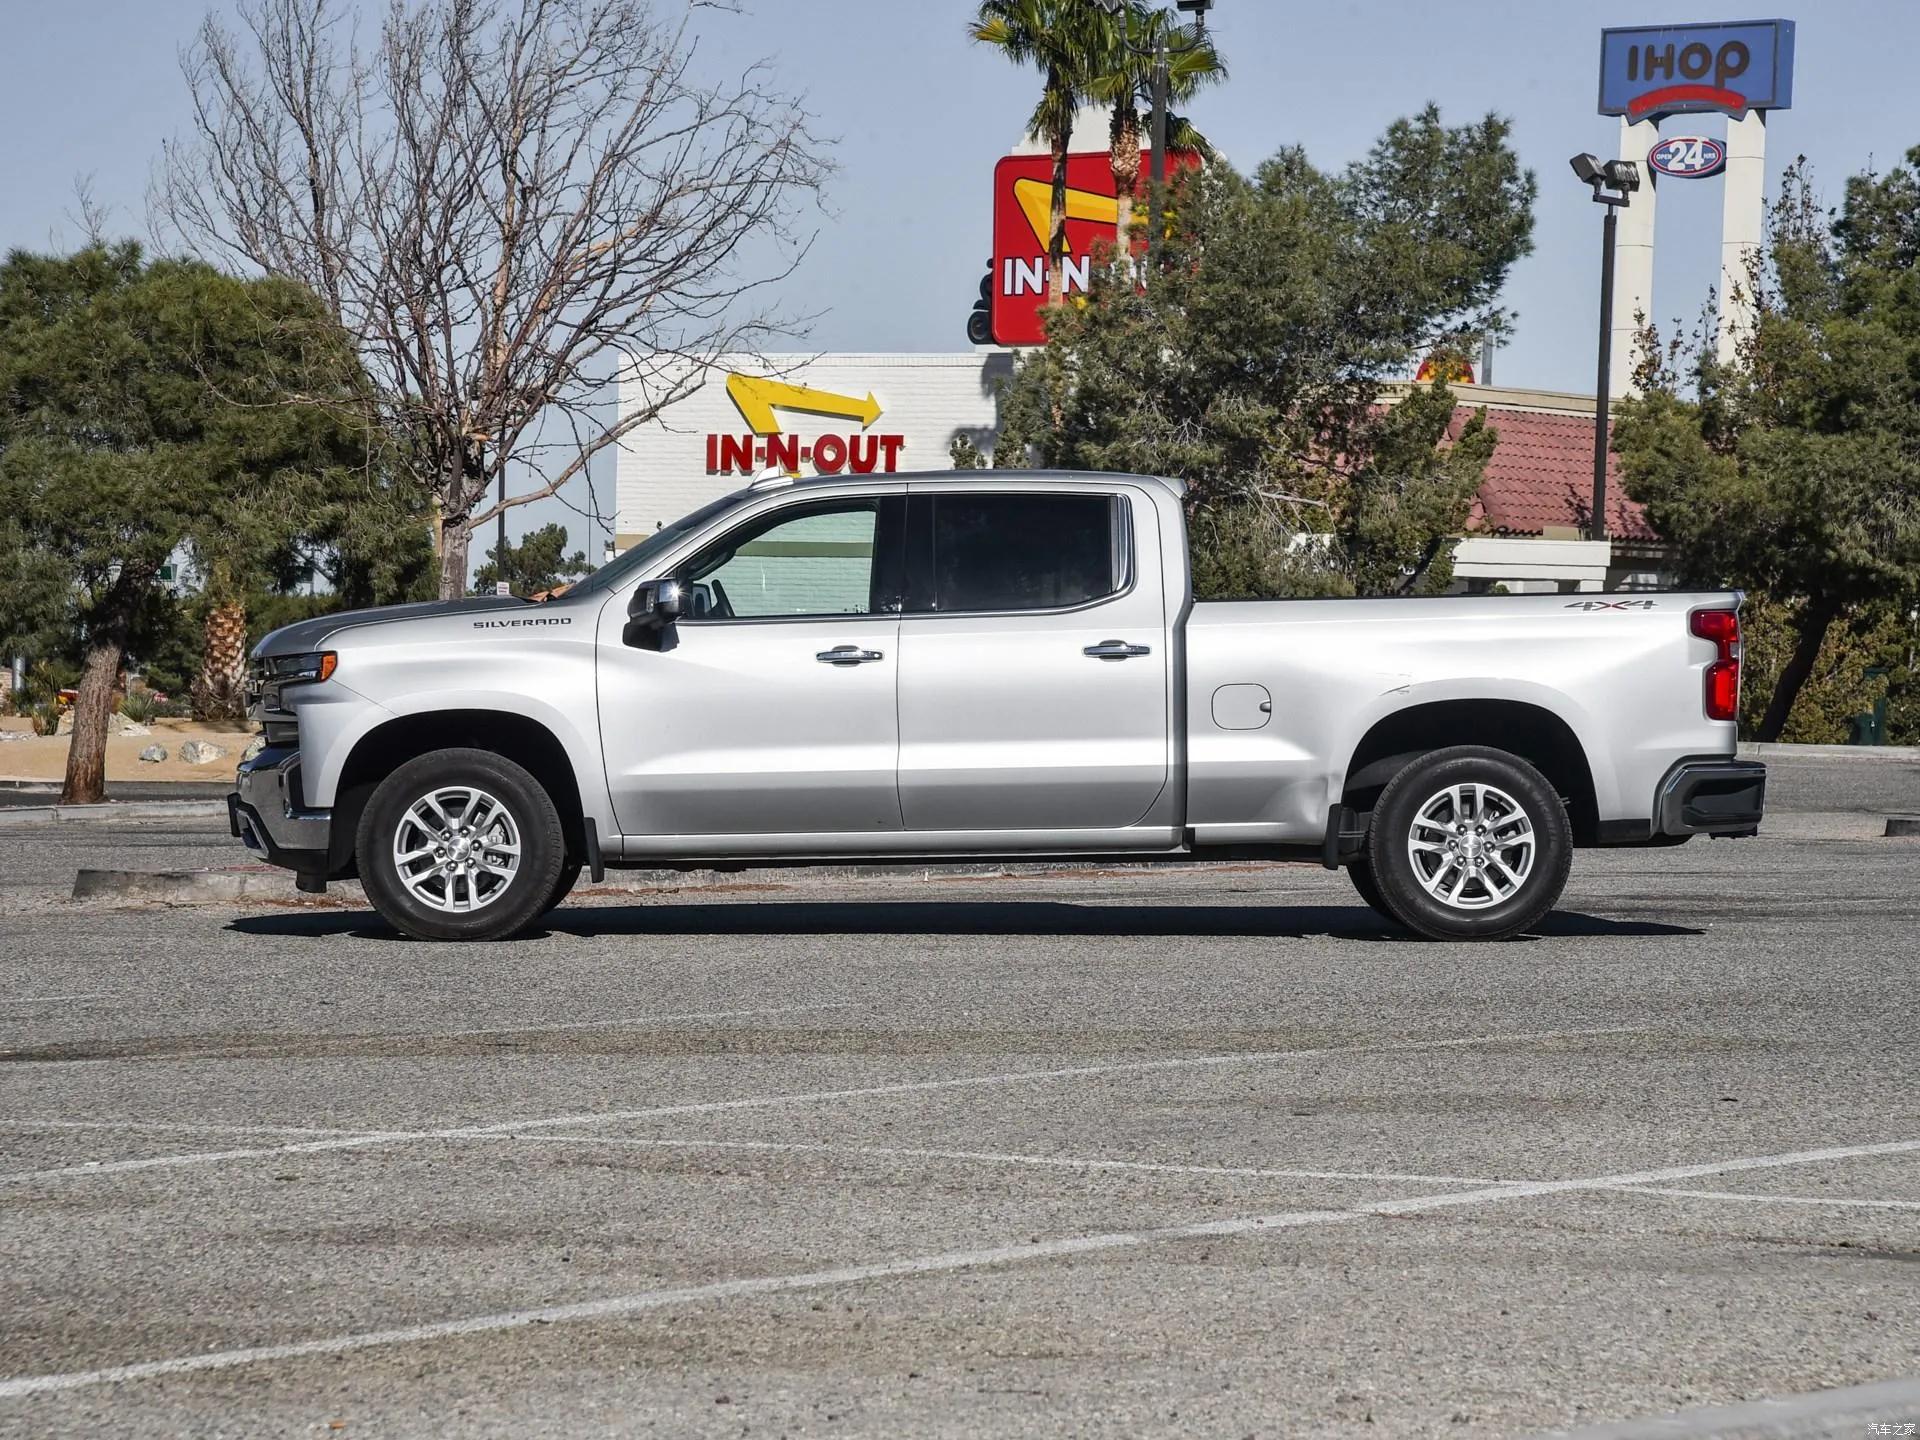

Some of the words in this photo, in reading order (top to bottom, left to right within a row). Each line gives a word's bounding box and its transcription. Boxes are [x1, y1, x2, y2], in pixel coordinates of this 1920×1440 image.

[1628, 40, 1750, 89] IHOP
[1667, 136, 1704, 171] 24
[706, 433, 906, 475] IN-N-OUT
[473, 617, 572, 629] SILVERADO
